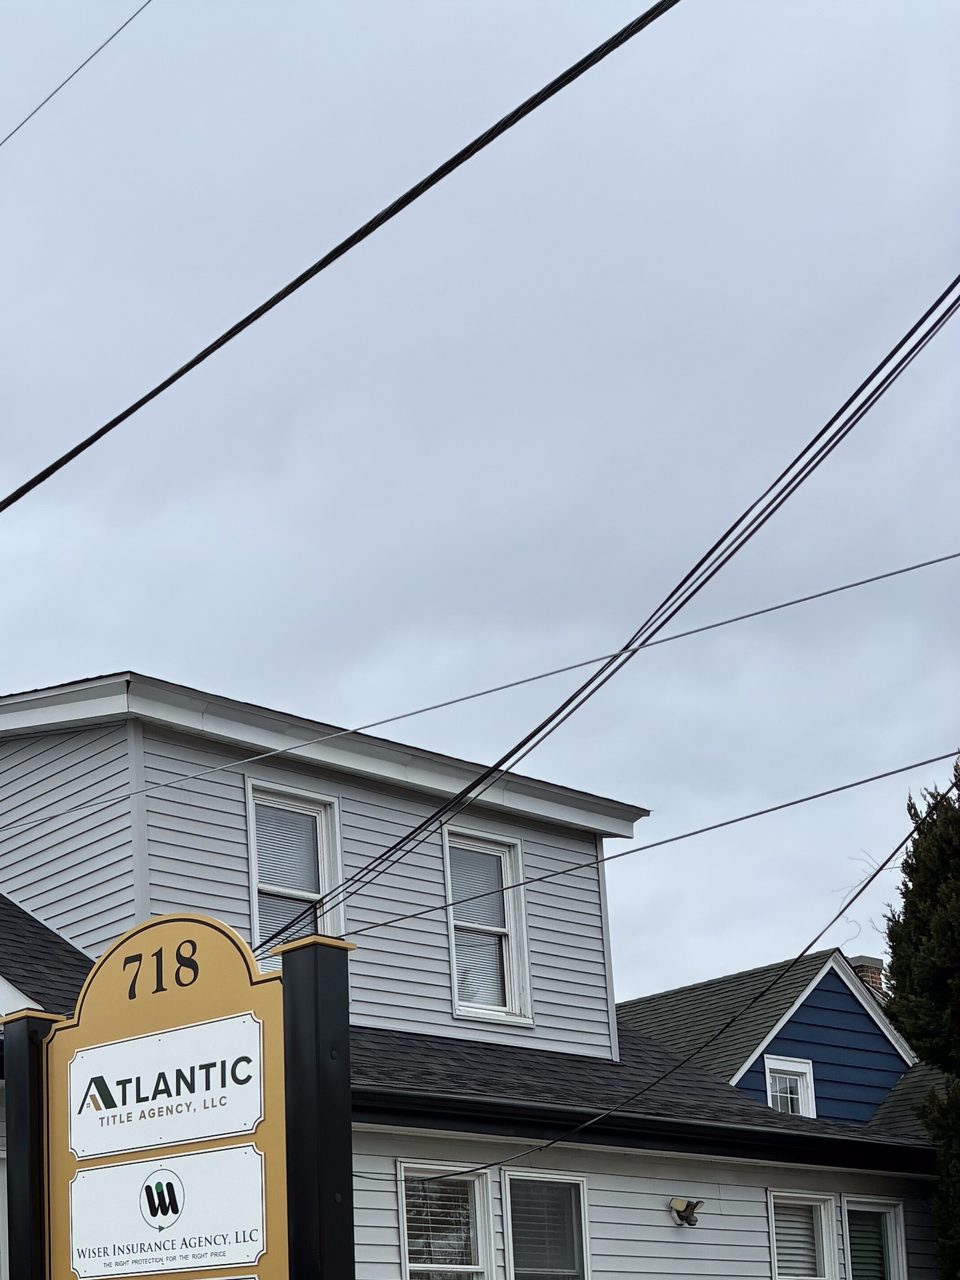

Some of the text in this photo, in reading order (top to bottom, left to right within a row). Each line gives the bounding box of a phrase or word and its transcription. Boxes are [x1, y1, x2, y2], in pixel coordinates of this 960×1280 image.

[123, 940, 199, 1000] 718
[77, 1055, 253, 1115] ATLANTIC
[99, 1095, 227, 1127] TITLE AGENCY, LLC
[112, 1239, 177, 1257] INSURANCE
[235, 1229, 259, 1244] LLC
[114, 1259, 130, 1267] RIGHT
[131, 1256, 164, 1265] PROTECTION
[191, 1252, 208, 1260] RIGHT
[210, 1250, 227, 1258] PRICE
